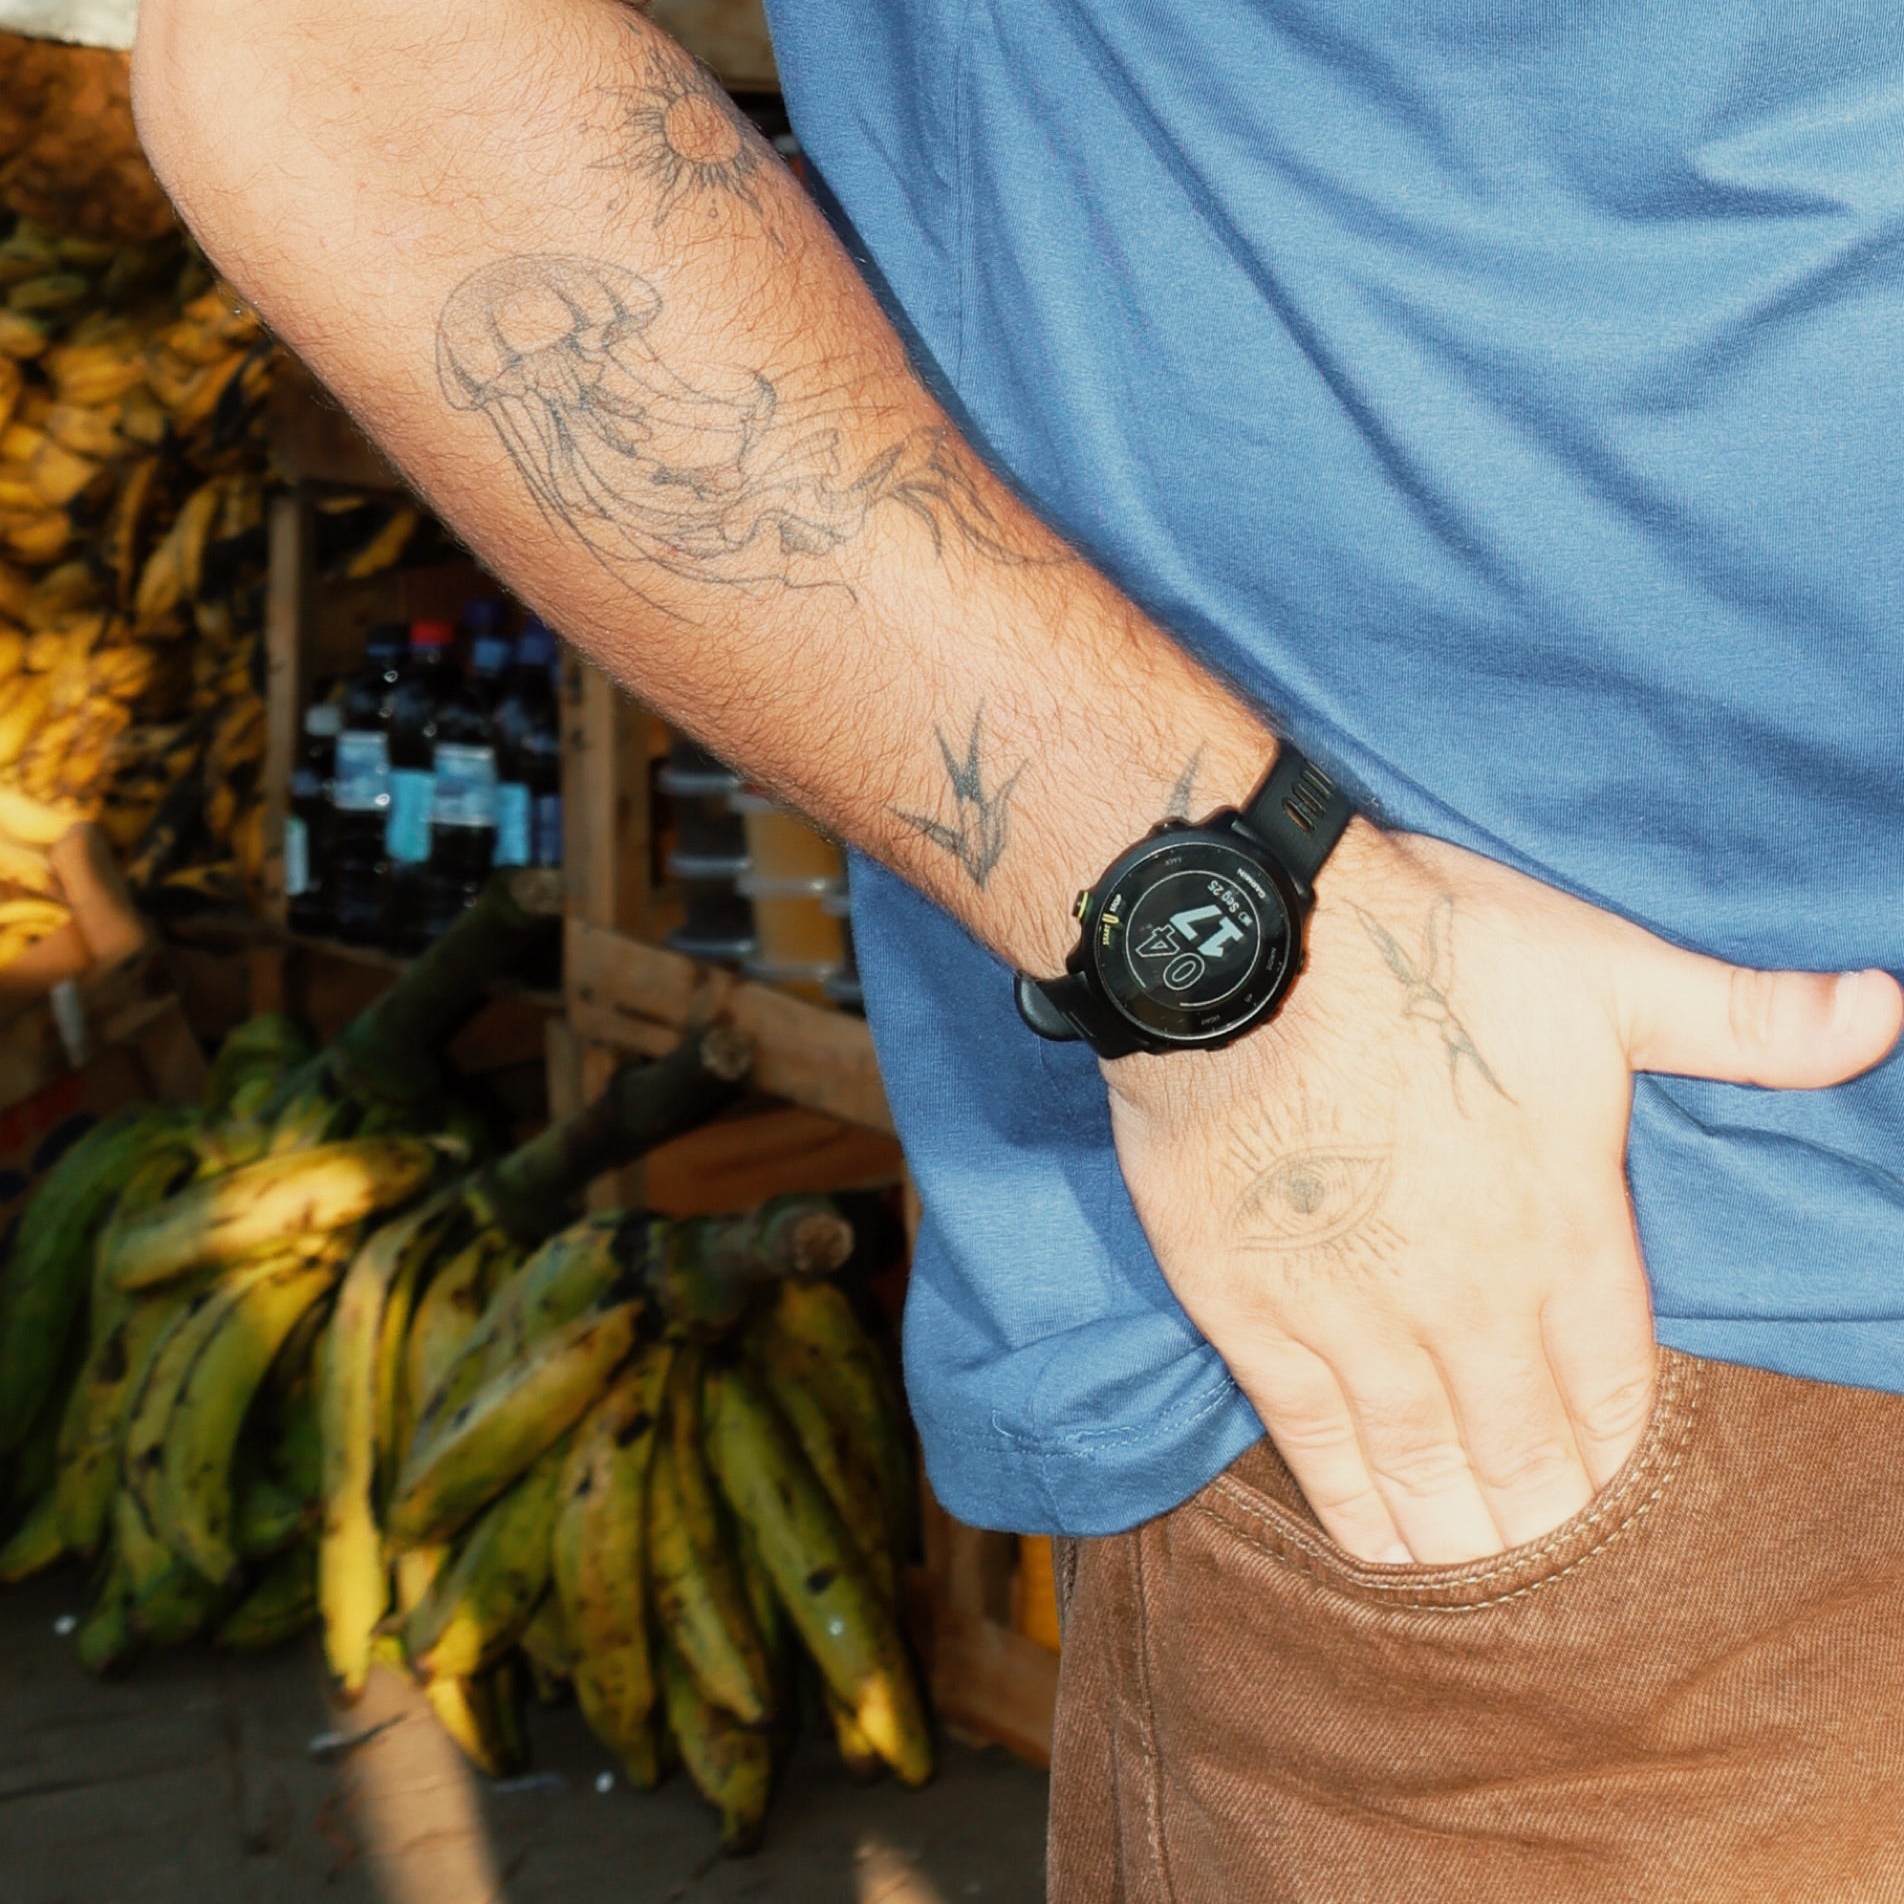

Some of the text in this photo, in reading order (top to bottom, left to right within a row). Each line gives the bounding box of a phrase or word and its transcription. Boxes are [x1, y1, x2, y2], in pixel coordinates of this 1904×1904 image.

[1207, 879, 1225, 897] 25
[1237, 867, 1267, 900] GARMIN
[1169, 904, 1244, 957] 17
[1135, 923, 1205, 991] 04
